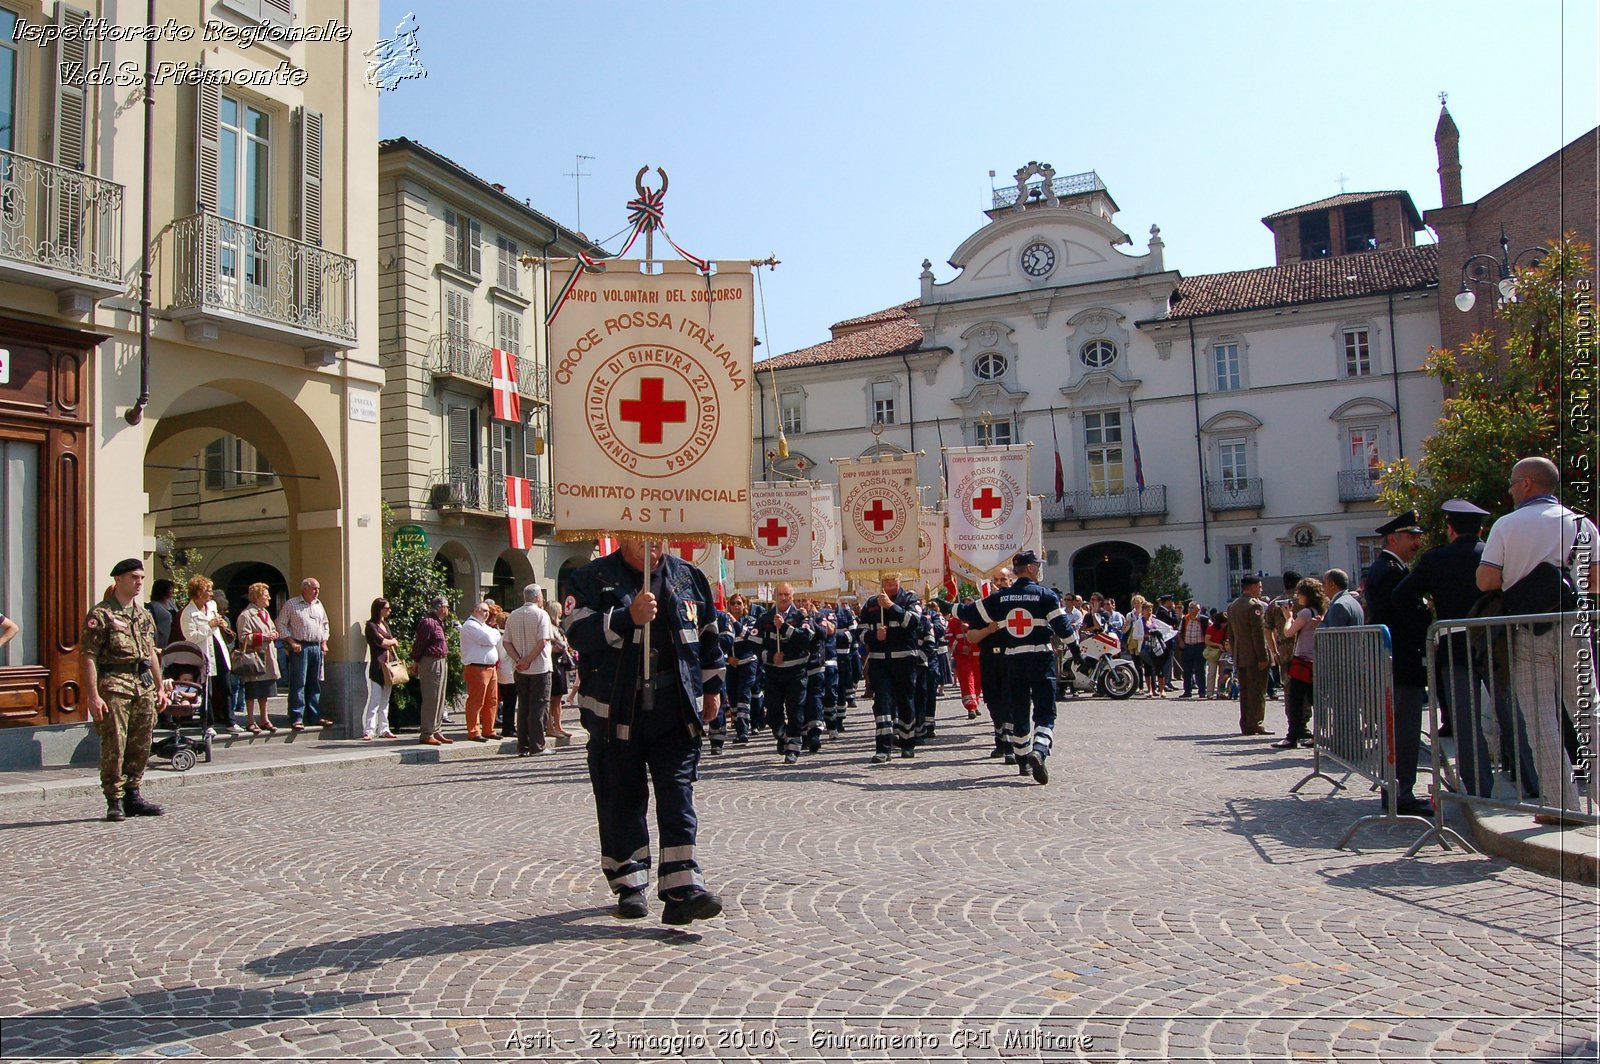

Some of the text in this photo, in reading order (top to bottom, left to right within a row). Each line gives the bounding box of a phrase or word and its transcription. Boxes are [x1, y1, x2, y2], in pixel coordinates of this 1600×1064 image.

[566, 287, 742, 303] ORPO VOLONTARI DEL SOCCORSO
[555, 311, 746, 392] CROCE ROSSA ITALIANA
[591, 350, 715, 470] CONVENZIONE DI GINEVRA 22 AGOSTO 1864
[954, 467, 1022, 499] CROCE ROSSA ITALIANA
[557, 482, 747, 503] COMITATO PROVINCIALE
[843, 477, 915, 513] CROCE ROSSA ITALIANA
[621, 508, 685, 523] ASTI
[756, 498, 806, 527] ROSSA ITALIANA
[397, 534, 425, 543] PIZZA
[857, 546, 883, 554] GRUPPO
[954, 543, 1017, 551] PIOVA' MASSAIA
[859, 556, 904, 565] MONALE
[758, 568, 789, 576] BARGE
